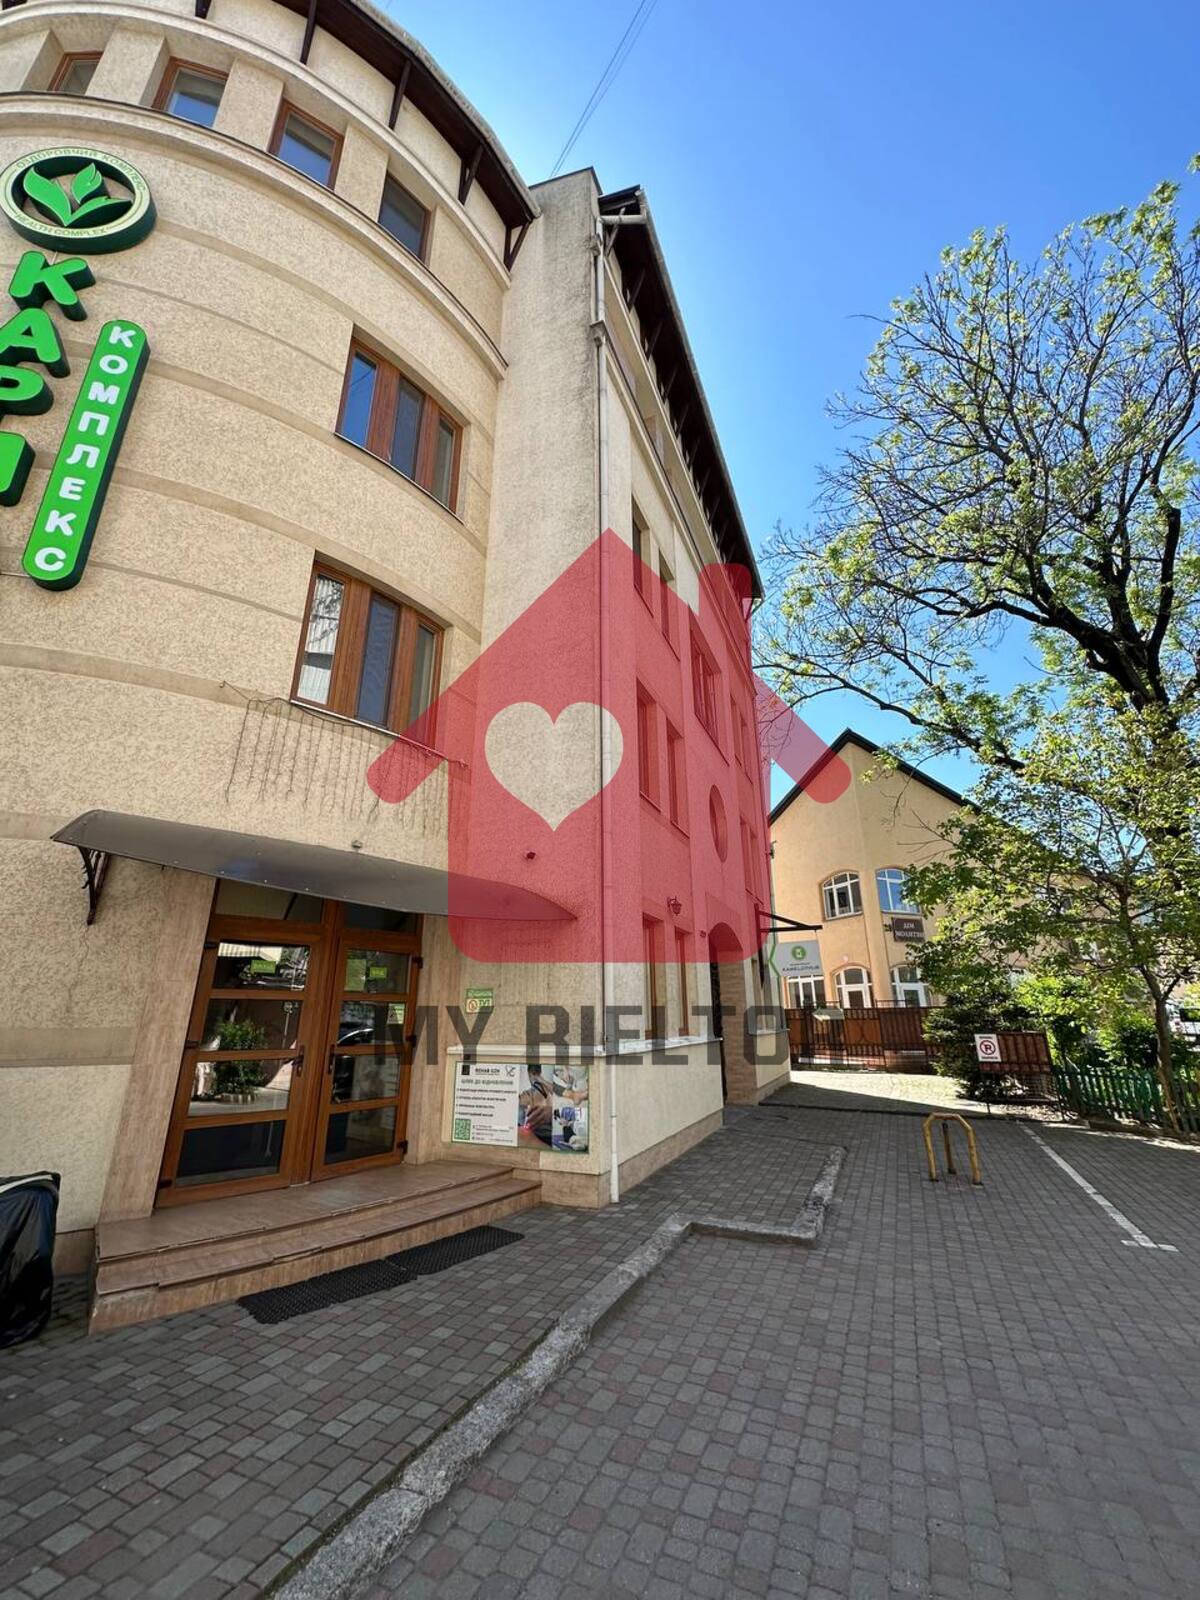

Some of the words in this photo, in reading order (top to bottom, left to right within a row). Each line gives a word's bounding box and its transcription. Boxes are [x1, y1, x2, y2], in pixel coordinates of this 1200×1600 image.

[14, 211, 53, 235] HEALTH
[53, 226, 107, 238] COMPLEX
[34, 325, 137, 572] КОМПЛЕКС
